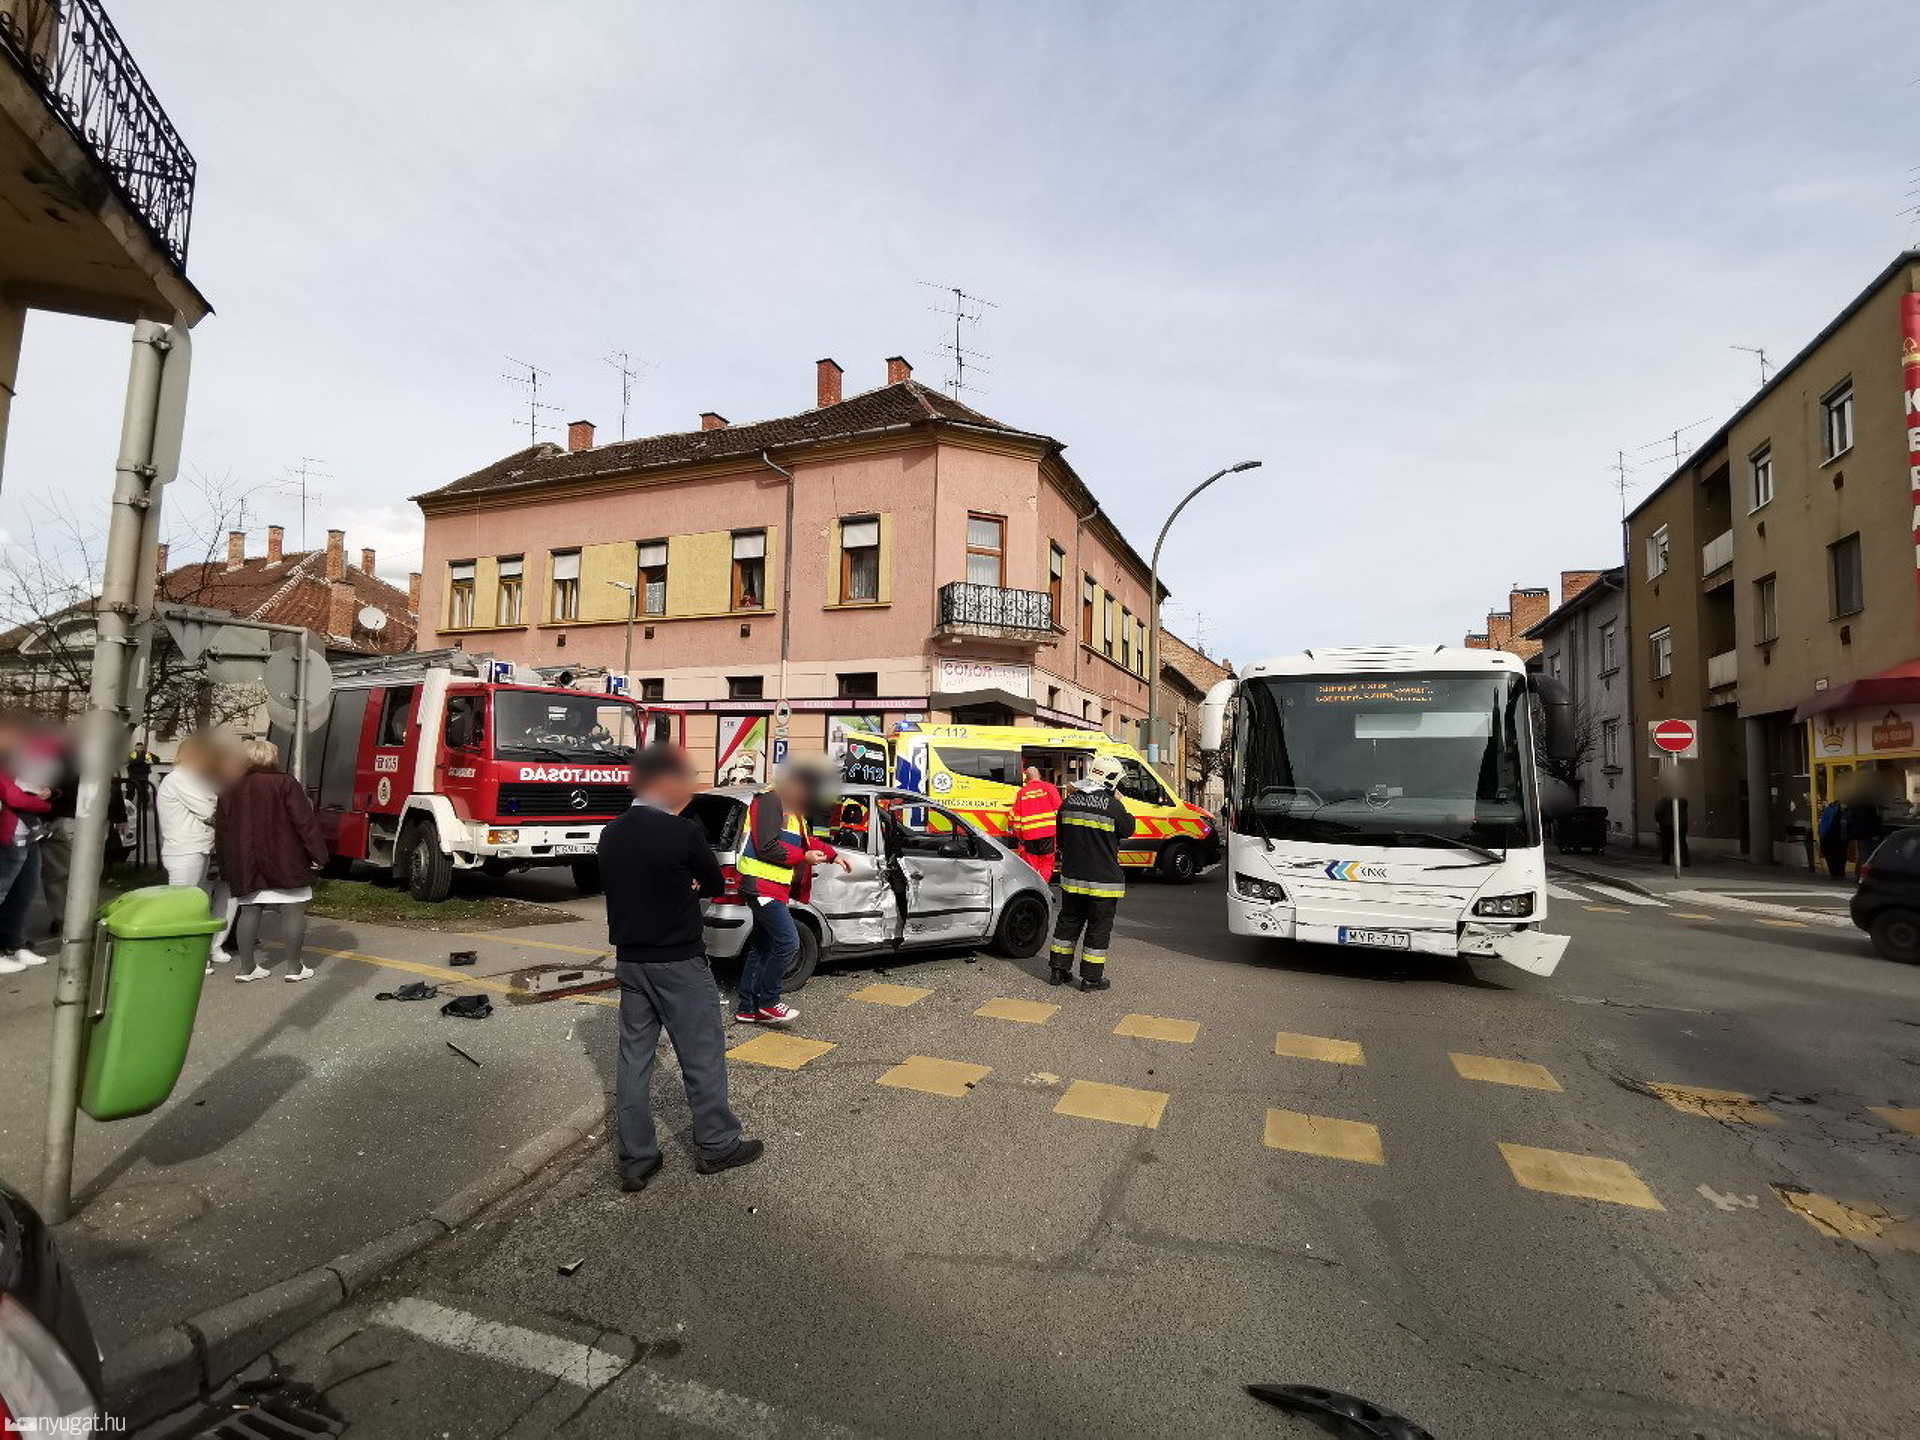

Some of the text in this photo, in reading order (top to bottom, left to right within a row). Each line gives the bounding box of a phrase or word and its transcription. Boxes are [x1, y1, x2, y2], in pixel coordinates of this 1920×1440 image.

[945, 728, 968, 738] 112
[775, 741, 786, 762] P
[862, 765, 885, 783] 112
